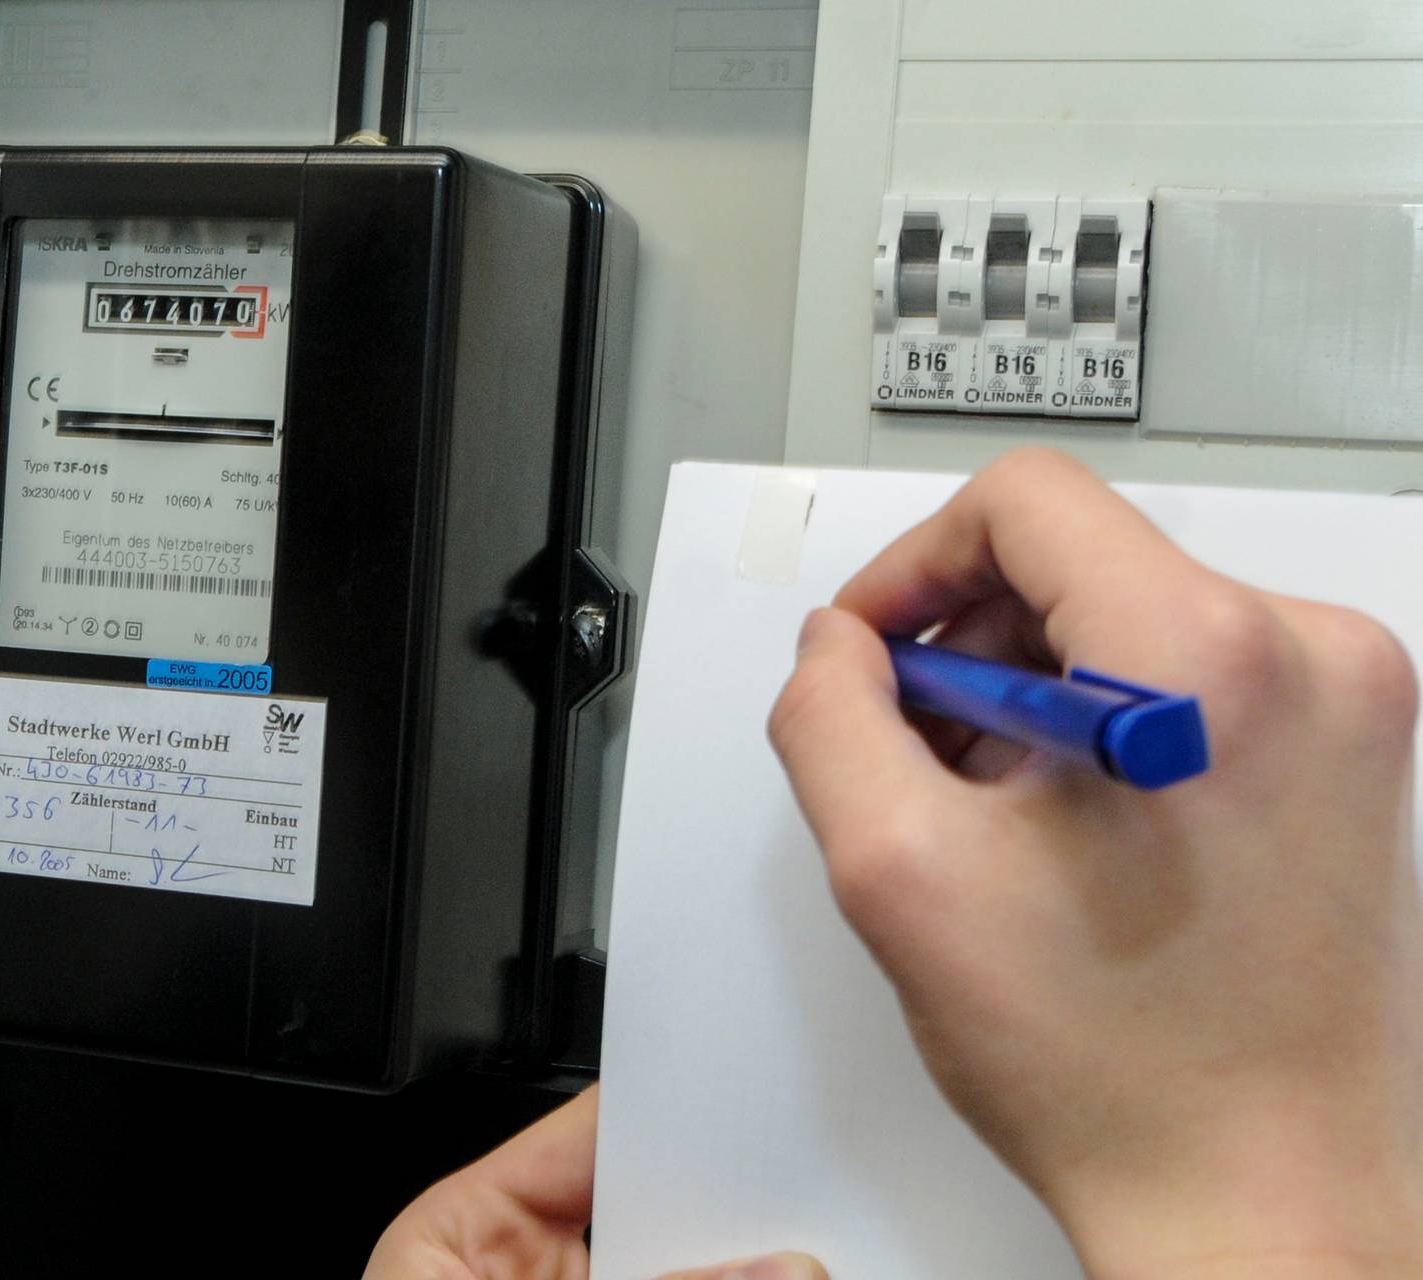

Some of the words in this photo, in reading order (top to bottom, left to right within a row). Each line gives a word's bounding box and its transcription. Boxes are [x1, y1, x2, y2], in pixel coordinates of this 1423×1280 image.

[38, 236, 89, 252] ISKRA
[144, 244, 171, 255] Made
[173, 245, 181, 255] in
[184, 245, 225, 256] Slovenia
[104, 260, 247, 281] Drehstromzähler
[896, 388, 954, 400] LINDNER
[983, 391, 1043, 403] LINDNER
[1071, 395, 1133, 408] LINDNER
[24, 459, 50, 474] Type
[54, 461, 109, 476] T3F-01S
[220, 470, 262, 487] Schltg.
[21, 485, 80, 501] 3x230/400
[83, 488, 93, 501] V
[110, 491, 125, 504] 50
[128, 492, 144, 505] Hz
[165, 494, 202, 510] 10(60)
[203, 496, 213, 508] A
[235, 498, 251, 511] 75
[62, 530, 121, 548] Eigentum
[127, 536, 151, 549] des
[157, 535, 255, 556] Netzbetreibers
[76, 549, 242, 575] 444003-5150763
[193, 632, 209, 647] Nr.
[216, 633, 231, 647] 40
[236, 635, 258, 649] 074
[169, 663, 197, 675] EWG
[217, 668, 268, 691] 2005
[266, 703, 305, 733] SW
[7, 714, 111, 741] Stadtwerke
[116, 725, 161, 746] Werl
[167, 730, 231, 753] GmbH
[47, 745, 98, 765] Telefon
[102, 751, 187, 773] 02922/985-0
[70, 790, 158, 813] Zählerstand
[245, 808, 298, 828] Einbau
[273, 834, 298, 850] HT
[86, 862, 132, 882] Name:
[270, 856, 297, 874] NT
